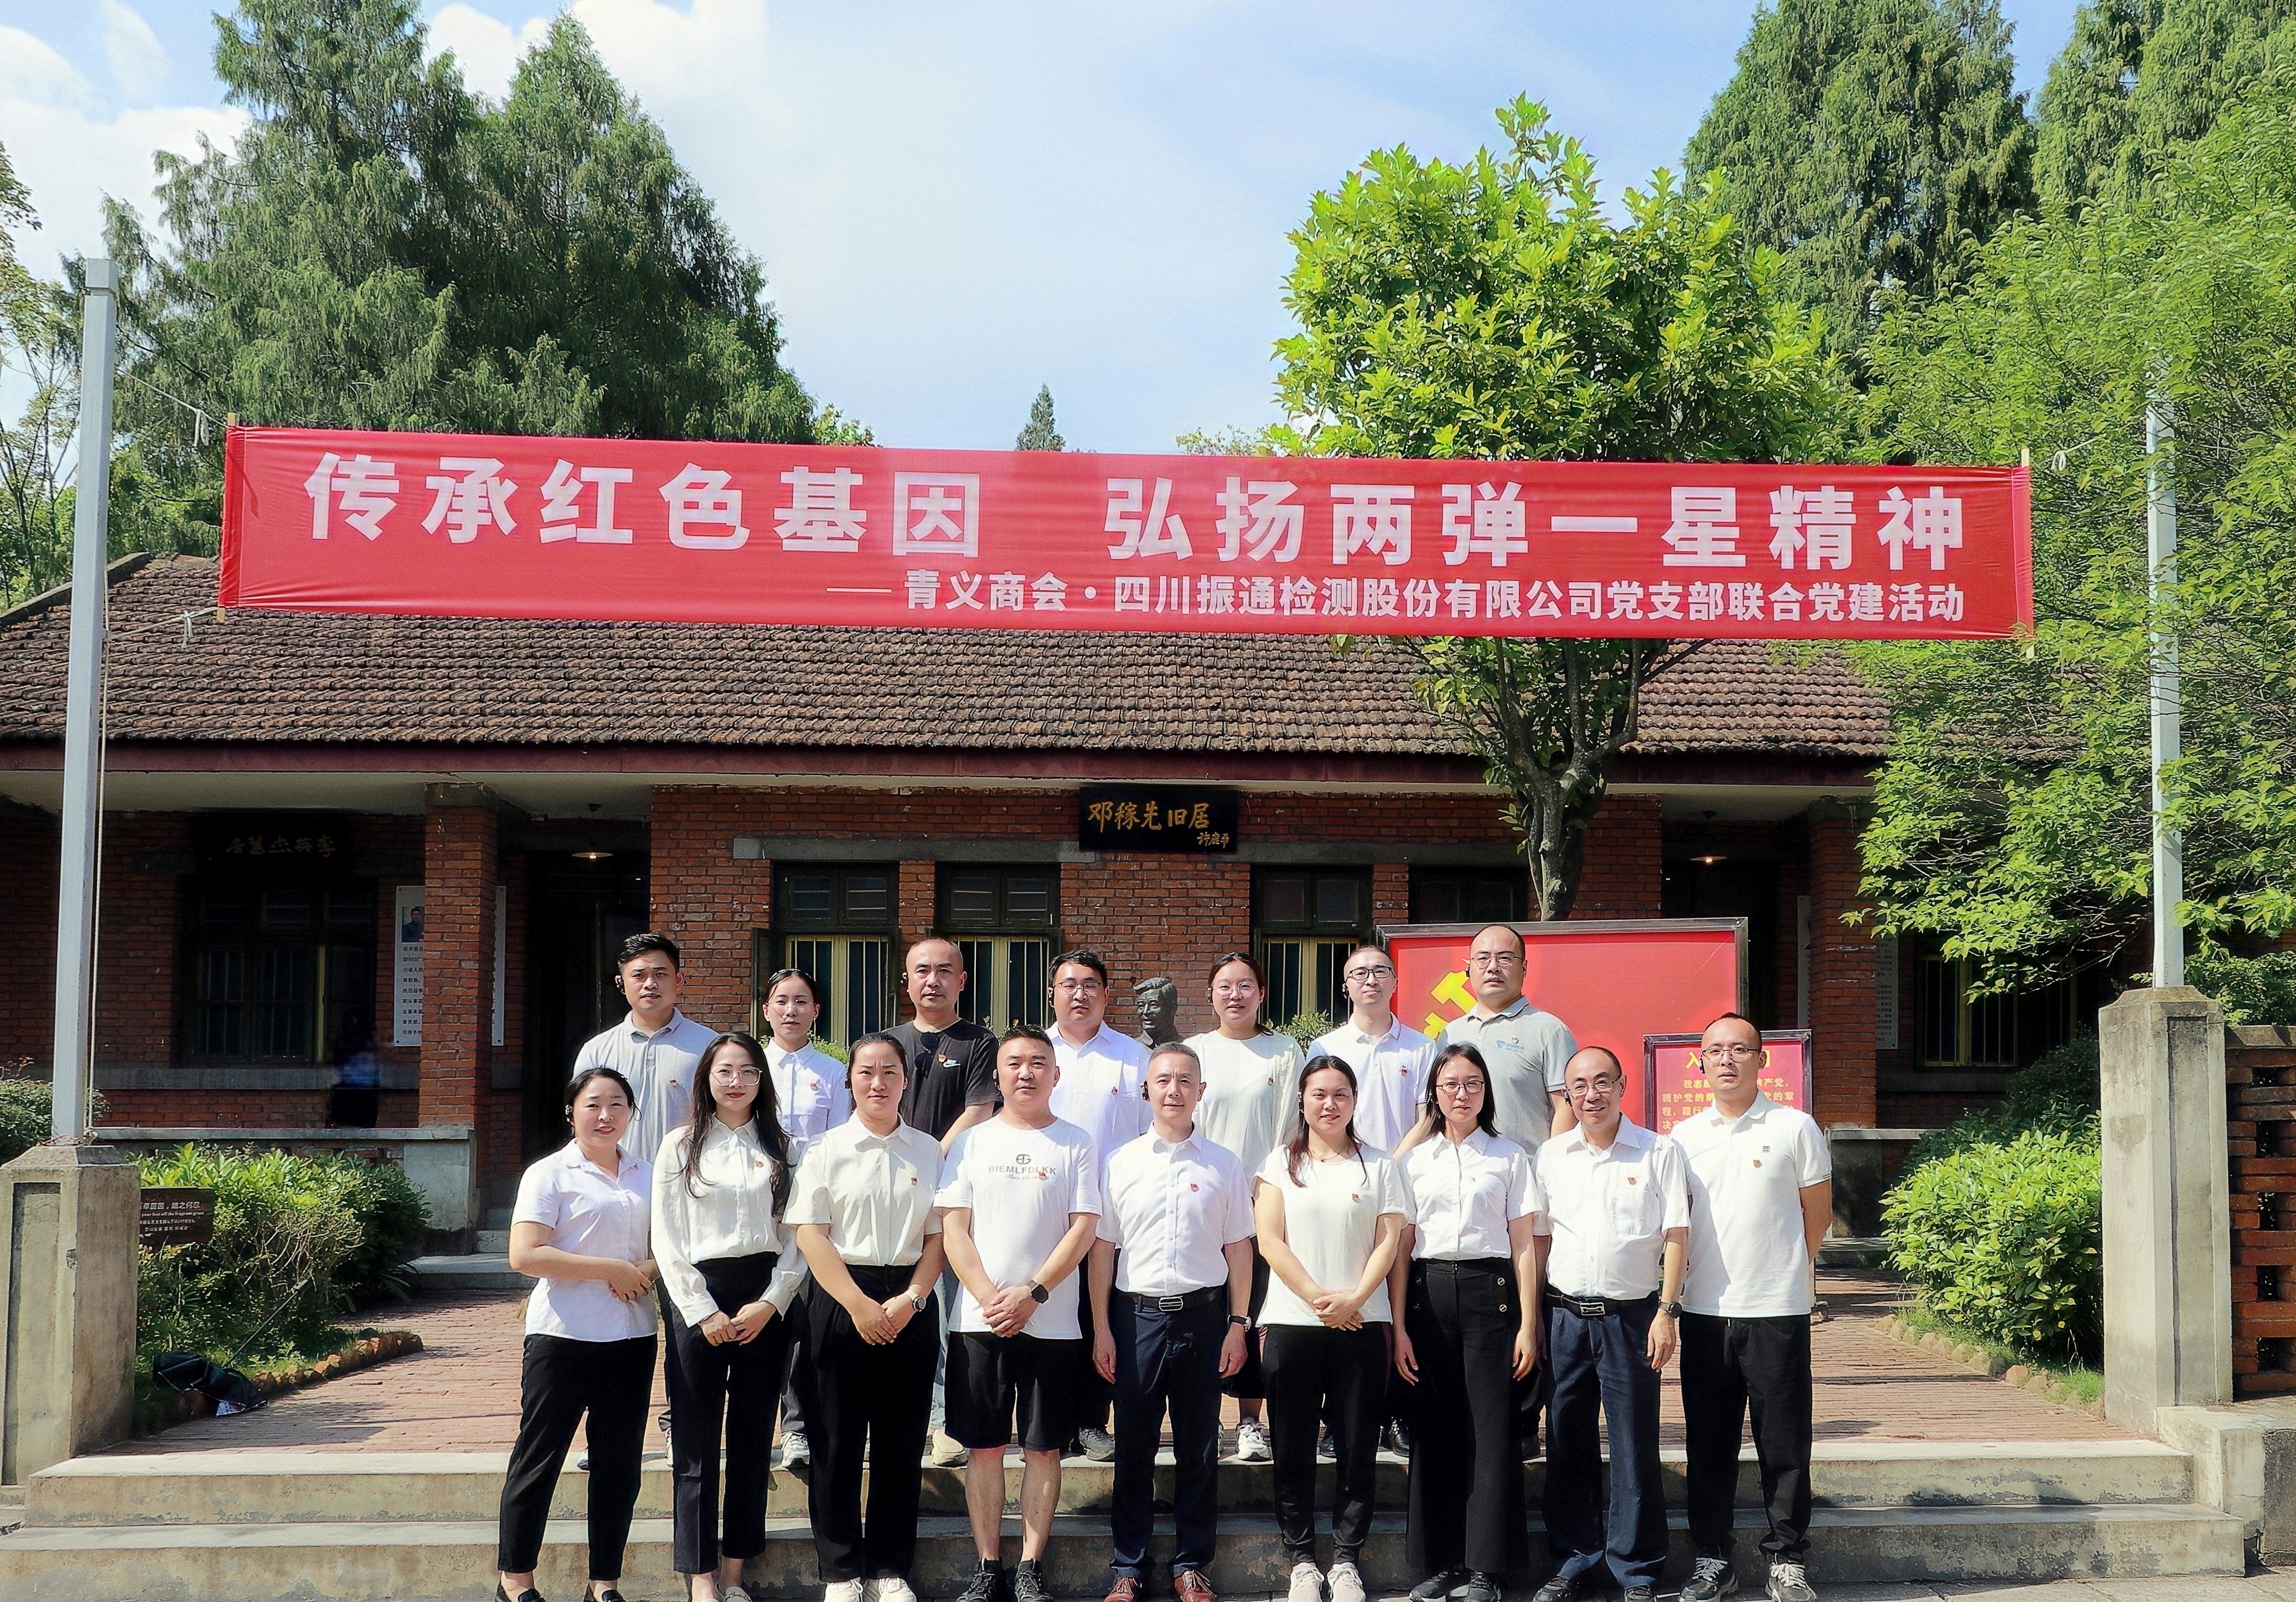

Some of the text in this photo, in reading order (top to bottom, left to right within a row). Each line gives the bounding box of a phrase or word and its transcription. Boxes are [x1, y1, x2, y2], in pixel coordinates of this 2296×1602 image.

[304, 453, 1962, 570] 传承红色基因 弘扬两弹一星精神
[1088, 801, 1210, 833] 邓稼先旧居
